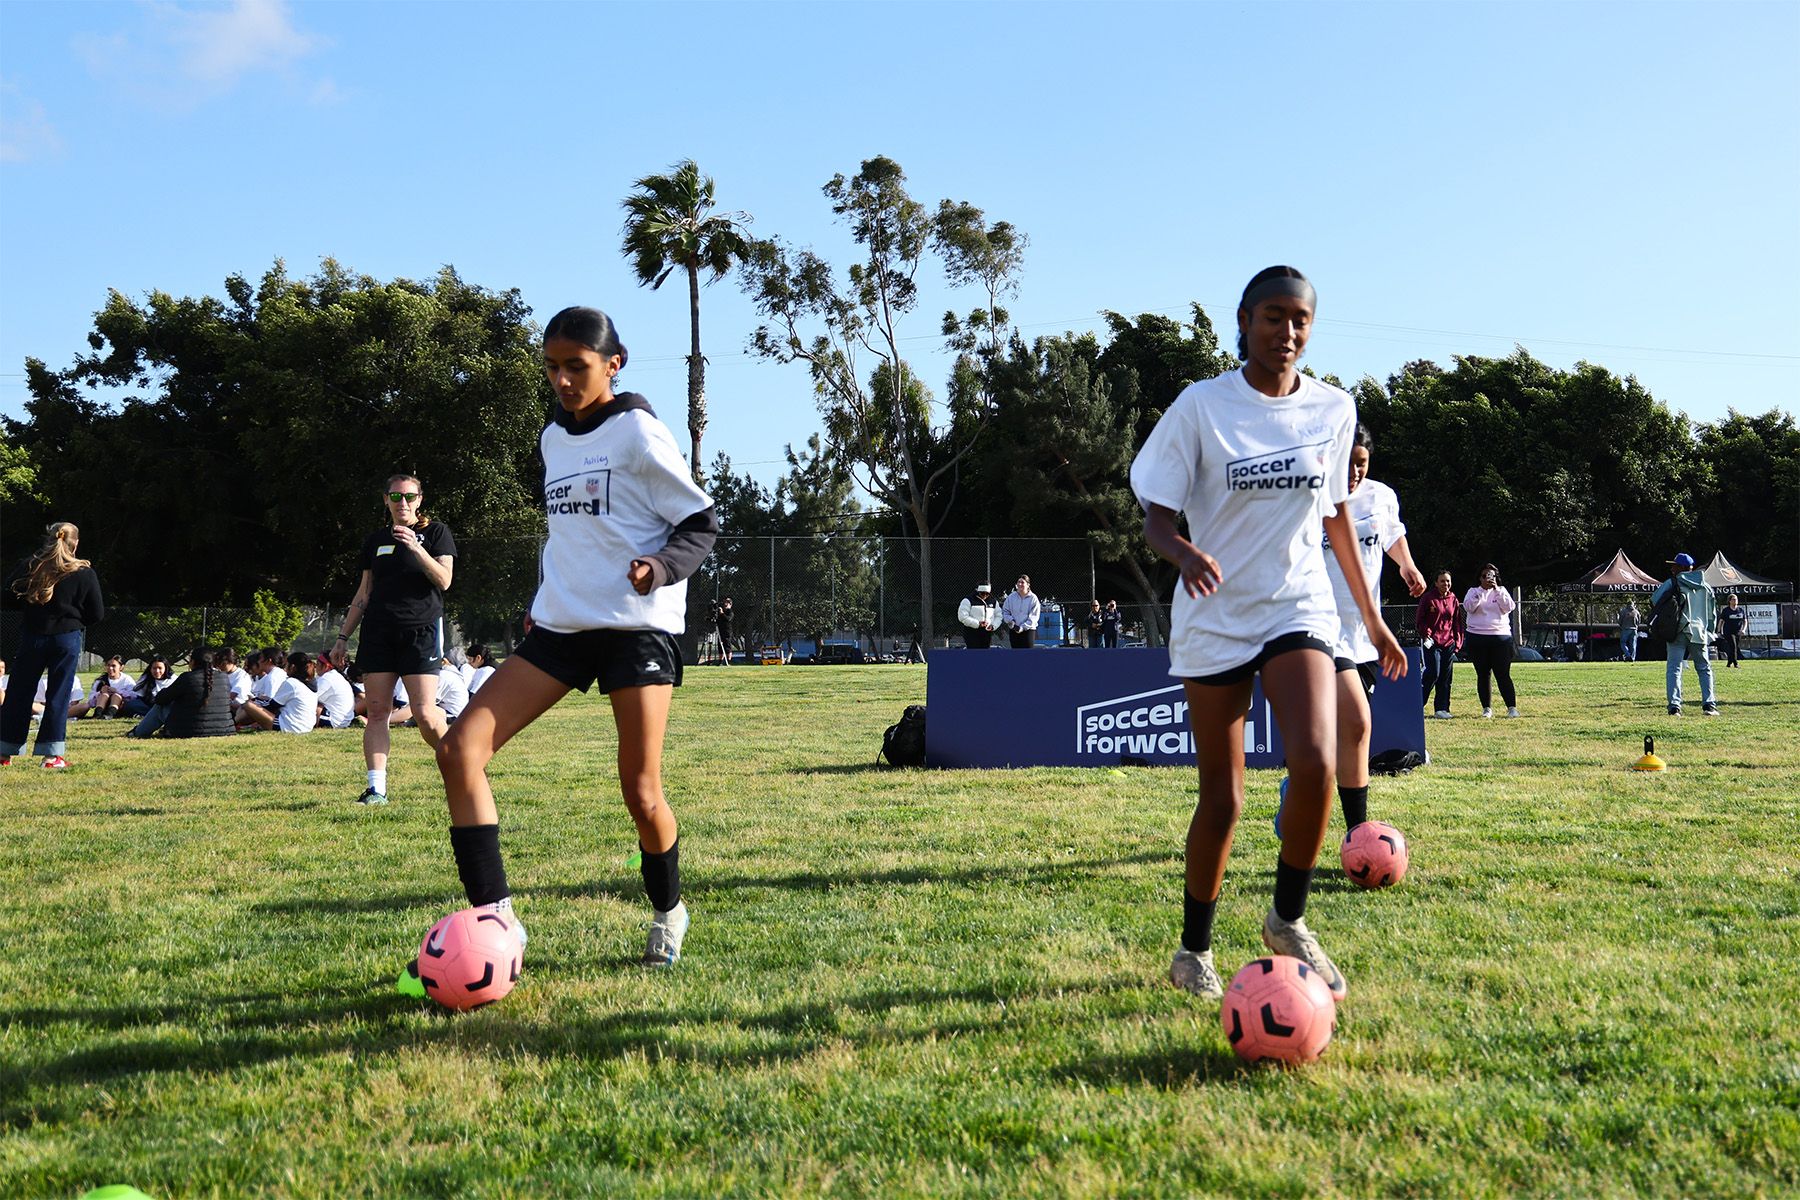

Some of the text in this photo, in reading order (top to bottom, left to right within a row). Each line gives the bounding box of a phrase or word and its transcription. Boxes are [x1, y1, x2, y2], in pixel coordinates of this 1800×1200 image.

[1232, 457, 1296, 478] soccer
[1232, 472, 1326, 491] forward
[547, 484, 572, 501] cer
[548, 498, 600, 516] ward
[1608, 583, 1639, 592] ANGEL
[1711, 585, 1776, 594] NGEL CITY FC
[1086, 701, 1189, 732] soccer
[1086, 721, 1255, 754] forwa
